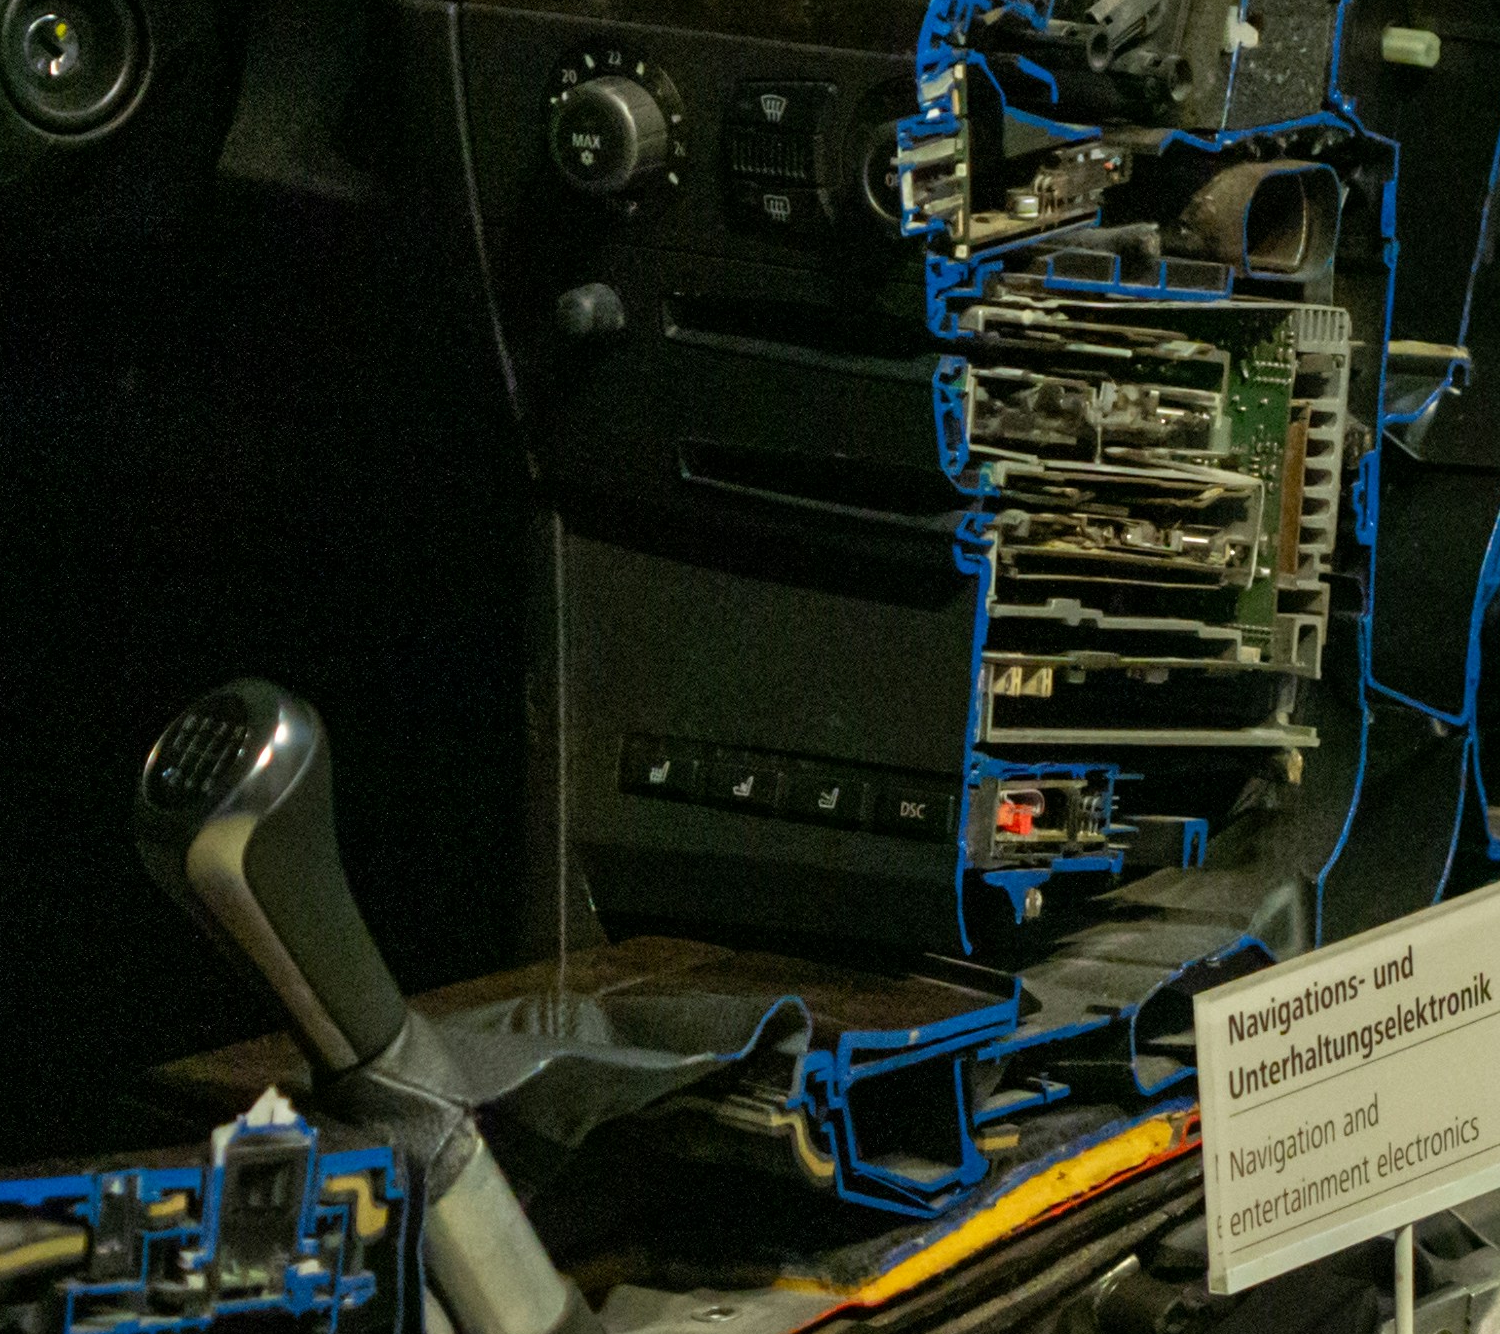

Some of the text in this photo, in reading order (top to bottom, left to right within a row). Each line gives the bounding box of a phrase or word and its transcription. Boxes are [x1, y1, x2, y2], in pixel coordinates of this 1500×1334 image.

[571, 132, 601, 149] MAX
[900, 801, 927, 820] DSC
[1228, 944, 1415, 1046] Navigations- und
[1228, 972, 1493, 1100] Unterhaltungselektronik
[1229, 1093, 1380, 1182] Navigation and
[1230, 1114, 1480, 1237] entertainment electronics
